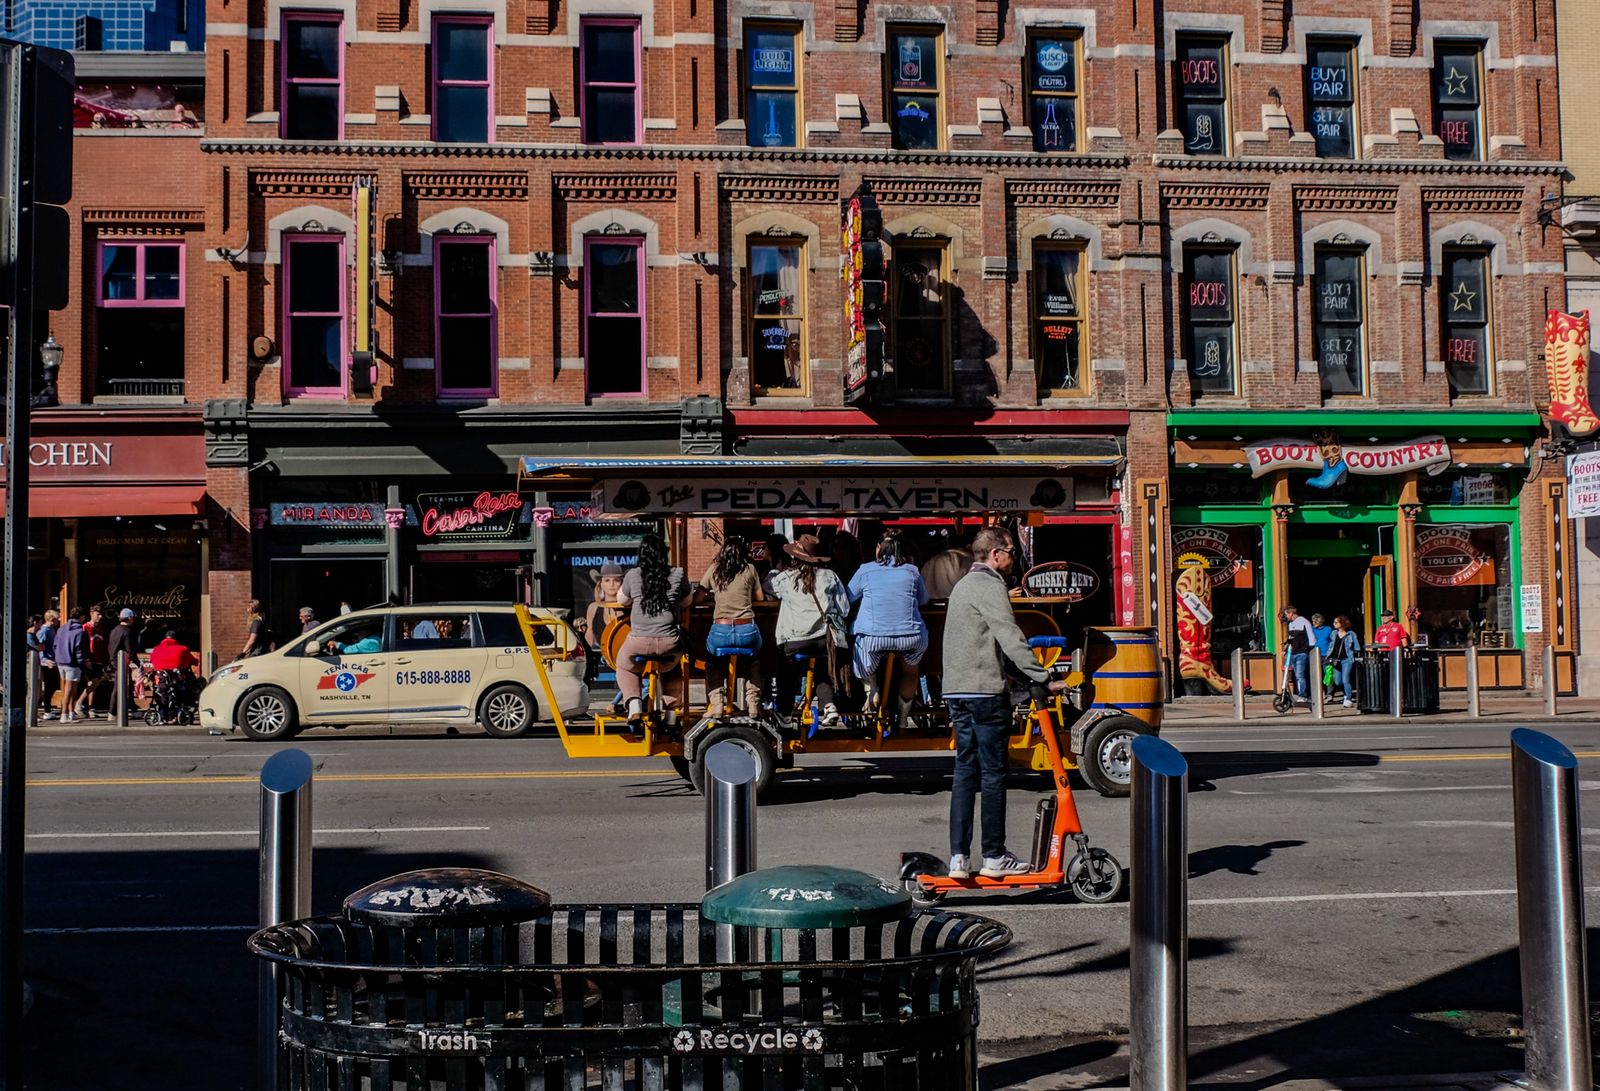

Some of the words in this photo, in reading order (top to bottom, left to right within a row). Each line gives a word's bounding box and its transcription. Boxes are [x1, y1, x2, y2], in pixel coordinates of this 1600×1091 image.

[759, 51, 785, 60] BUD
[1038, 52, 1067, 62] BUSCH
[755, 60, 790, 70] LIGHT
[1181, 60, 1218, 85] BOOTS
[1311, 66, 1339, 82] BUY
[1340, 68, 1346, 82] 1
[1313, 82, 1344, 97] PAIR
[1313, 109, 1332, 123] GET
[1336, 109, 1344, 123] 2
[1317, 123, 1341, 137] PAIR
[1440, 120, 1469, 145] FREE
[1190, 282, 1226, 306] BOOTS
[1321, 282, 1343, 296] BUY
[1044, 301, 1074, 309] Williams
[1048, 294, 1068, 302] Evan
[1324, 296, 1348, 310] PAIR
[1043, 325, 1073, 334] BULLEIT
[1320, 338, 1341, 352] GET
[1345, 338, 1353, 352] 2
[1447, 338, 1477, 363] FREE
[1325, 353, 1348, 366] PAIR
[1256, 444, 1318, 466] BOOT
[1345, 439, 1445, 468] COUNTRY
[1574, 462, 1600, 475] BOOTS
[747, 479, 942, 487] NASHVILLE
[657, 484, 695, 508] The
[701, 487, 840, 511] PEDAL
[1578, 493, 1598, 504] FREE
[281, 506, 372, 520] MIRANDA
[422, 508, 478, 536] Casa
[473, 490, 523, 521] Rosa
[552, 508, 592, 519] LAM
[1174, 528, 1227, 543] BOOTS
[1418, 528, 1469, 542] BOOTS
[1211, 543, 1232, 557] PAIR
[1455, 540, 1476, 555] PAIR
[1427, 557, 1445, 565] YOU
[1447, 556, 1464, 564] GET
[1027, 570, 1069, 588] WHISKEY
[1071, 571, 1094, 587] BENT
[1213, 565, 1235, 583] FREE
[1458, 566, 1478, 581] FREE
[141, 609, 182, 620] KITCHEN
[324, 663, 348, 676] TENN
[351, 663, 369, 674] CAB
[396, 670, 471, 685] 615-888-8888
[1050, 833, 1060, 859] SPIN
[418, 1030, 477, 1051] Trash
[700, 1028, 799, 1054] Recycle
